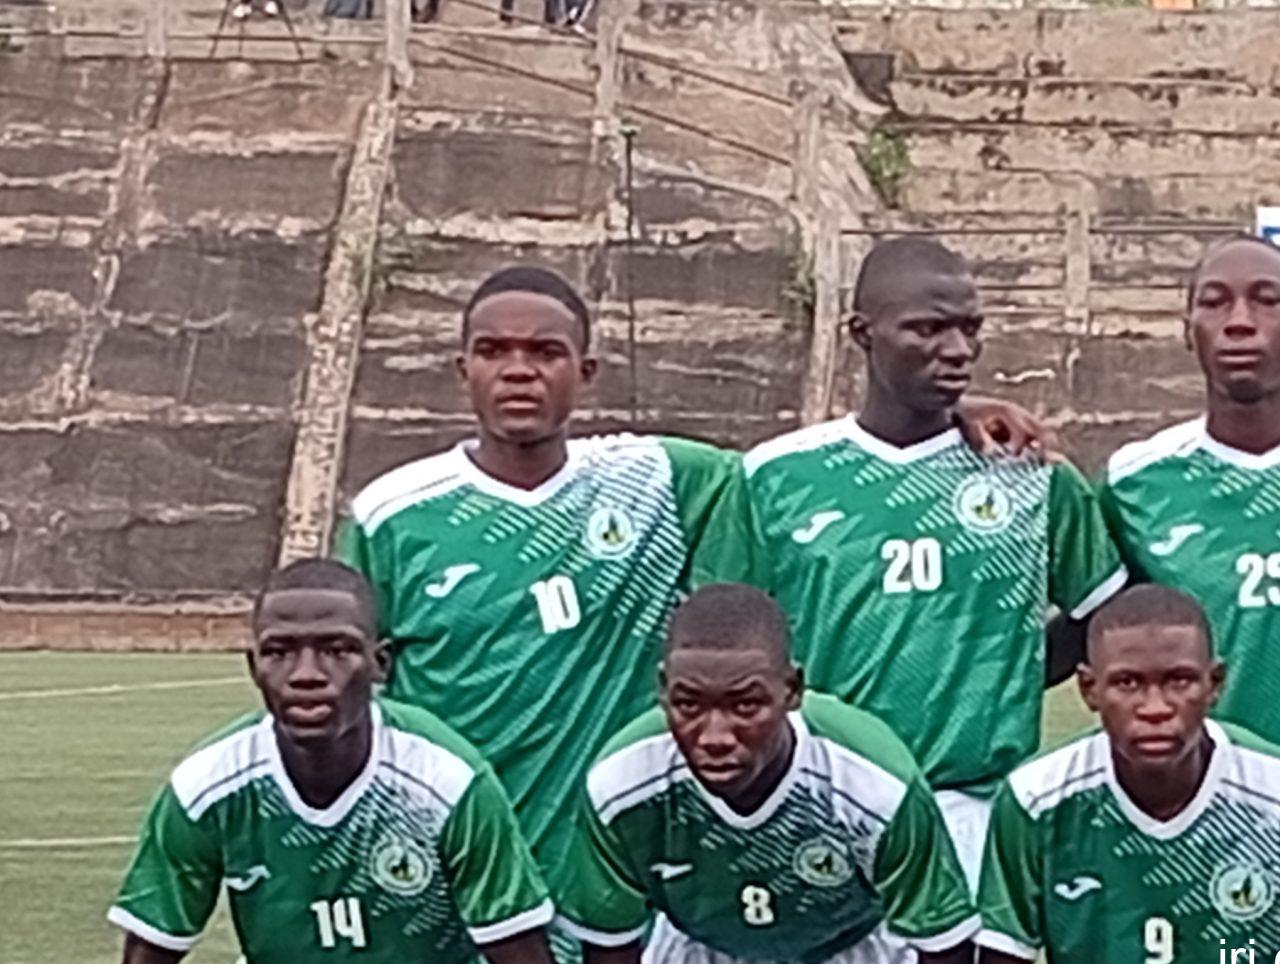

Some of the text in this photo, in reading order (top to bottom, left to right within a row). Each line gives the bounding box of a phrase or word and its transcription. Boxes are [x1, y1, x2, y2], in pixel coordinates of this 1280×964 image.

[881, 538, 942, 594] 20
[529, 574, 581, 634] 10
[310, 897, 366, 947] 14
[741, 885, 774, 925] 8
